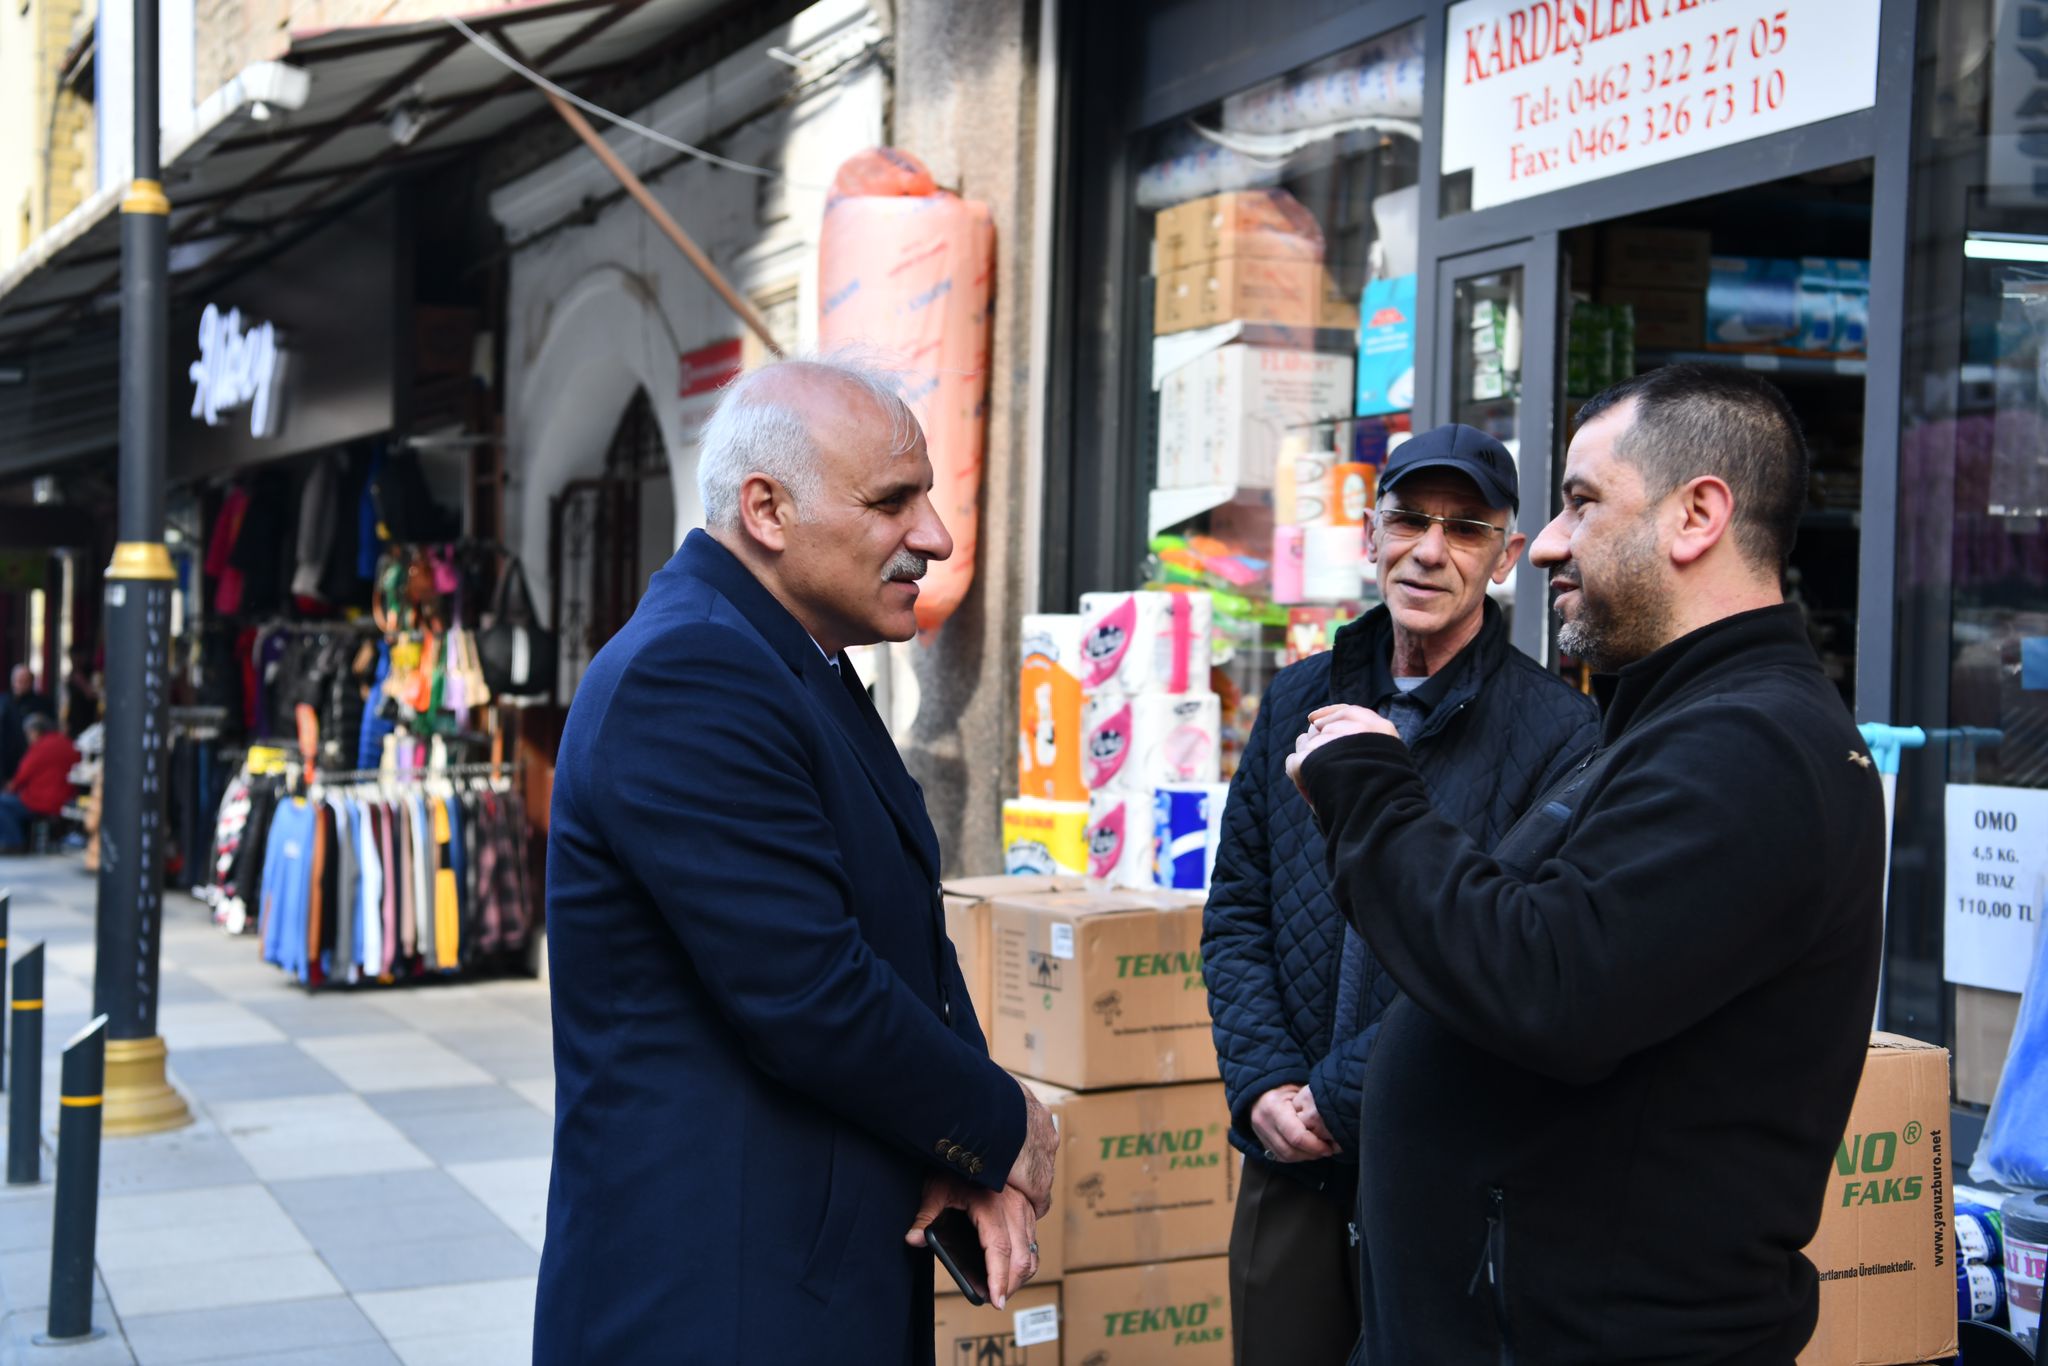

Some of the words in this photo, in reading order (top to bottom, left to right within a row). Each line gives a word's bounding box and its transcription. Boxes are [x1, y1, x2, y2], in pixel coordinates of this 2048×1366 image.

[1464, 0, 1652, 84] KARDEŞLER
[1513, 86, 1558, 132] Tel:
[1568, 63, 1630, 115] 0462
[1642, 42, 1692, 94] 322
[1704, 28, 1739, 73] 27
[1750, 11, 1789, 59] 05
[1510, 144, 1559, 181] Fax:
[1568, 115, 1630, 165] 0462
[1640, 96, 1692, 146] 326
[1704, 84, 1736, 129] 73
[1750, 69, 1786, 115] 10
[1974, 810, 2018, 832] OMO
[1972, 846, 1994, 862] 4,5
[1998, 848, 2019, 864] KG.
[1976, 872, 2015, 889] BEYAZ
[1959, 898, 2012, 919] 110,00
[2017, 904, 2035, 922] TL
[1099, 1128, 1203, 1160] TEKNO
[1169, 1153, 1219, 1170] FAKS
[1842, 1176, 1923, 1208] FAKS
[1930, 1130, 1946, 1267] www.yavuzburo.net
[1858, 1261, 1917, 1277] Üretilmektedir.
[1104, 1302, 1208, 1338] TEKNO
[1174, 1326, 1224, 1347] FAKS
